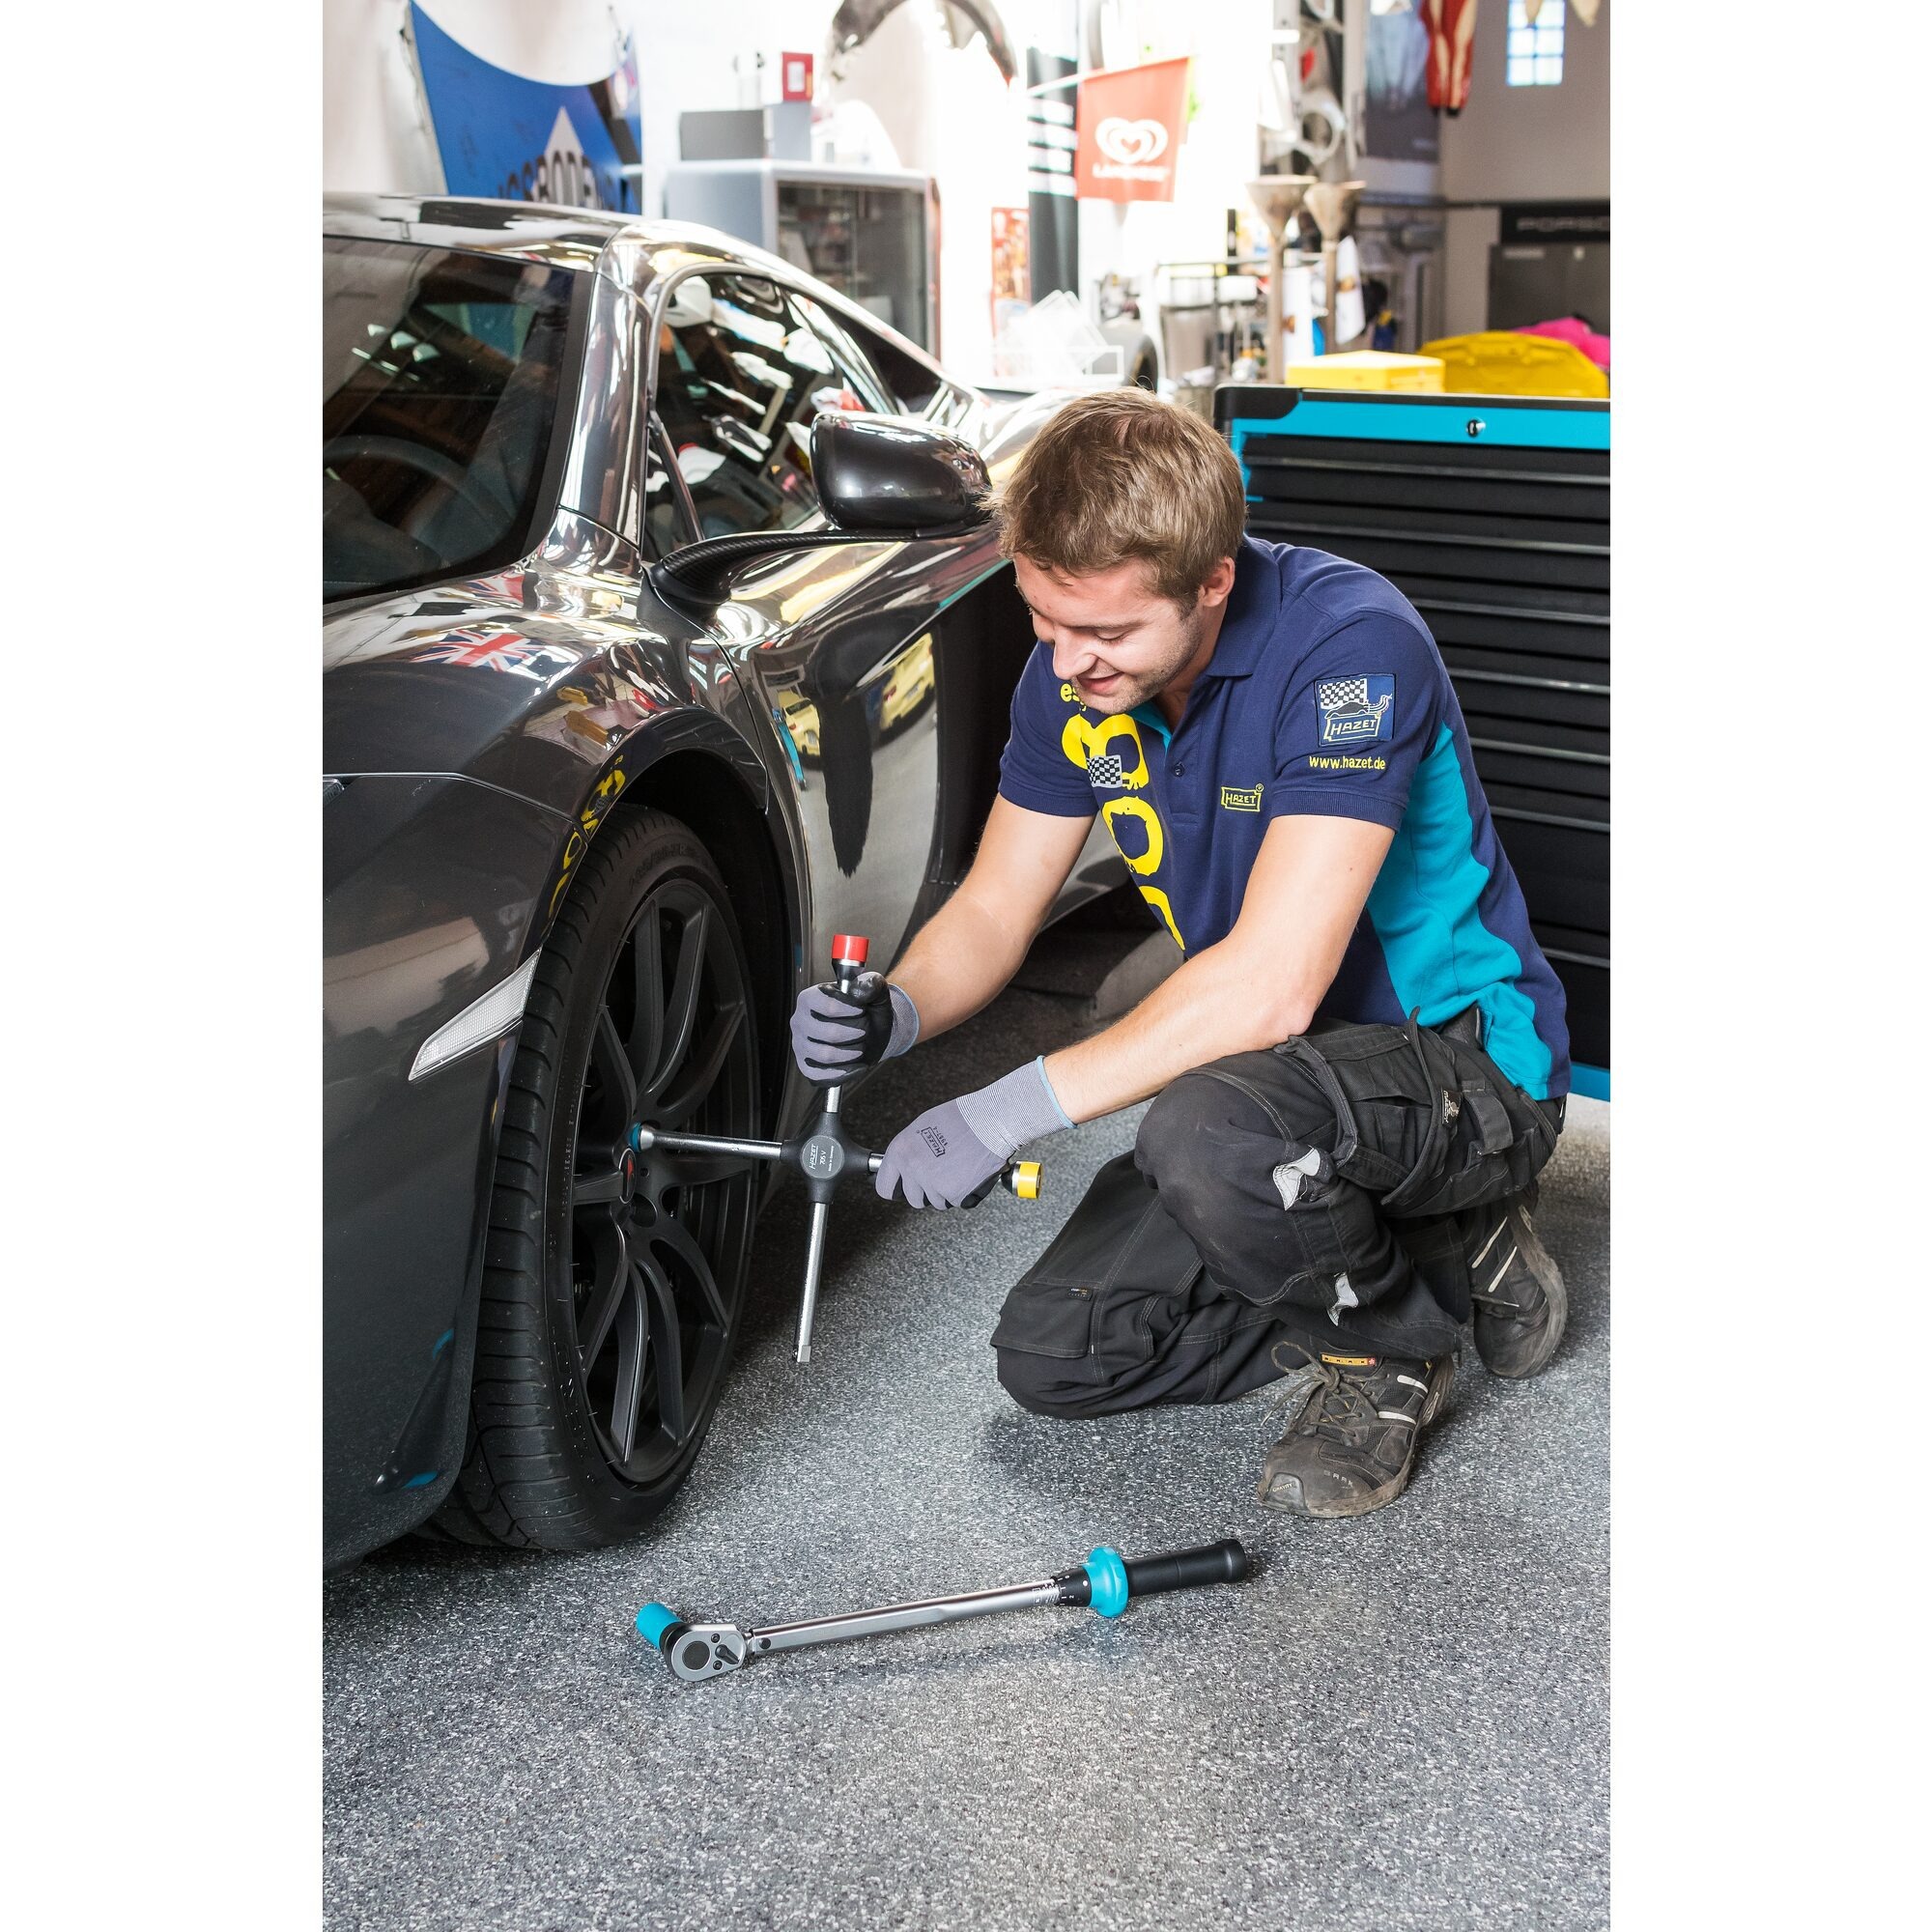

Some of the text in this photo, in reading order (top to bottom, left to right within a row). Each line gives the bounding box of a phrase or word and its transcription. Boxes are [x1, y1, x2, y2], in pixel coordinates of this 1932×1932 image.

[1329, 720, 1377, 736] HAZET
[1309, 755, 1386, 770] www.hazet.de
[1225, 793, 1257, 804] HAZET
[809, 1143, 817, 1170] HAZET
[1272, 1482, 1293, 1492] GRAVITY
